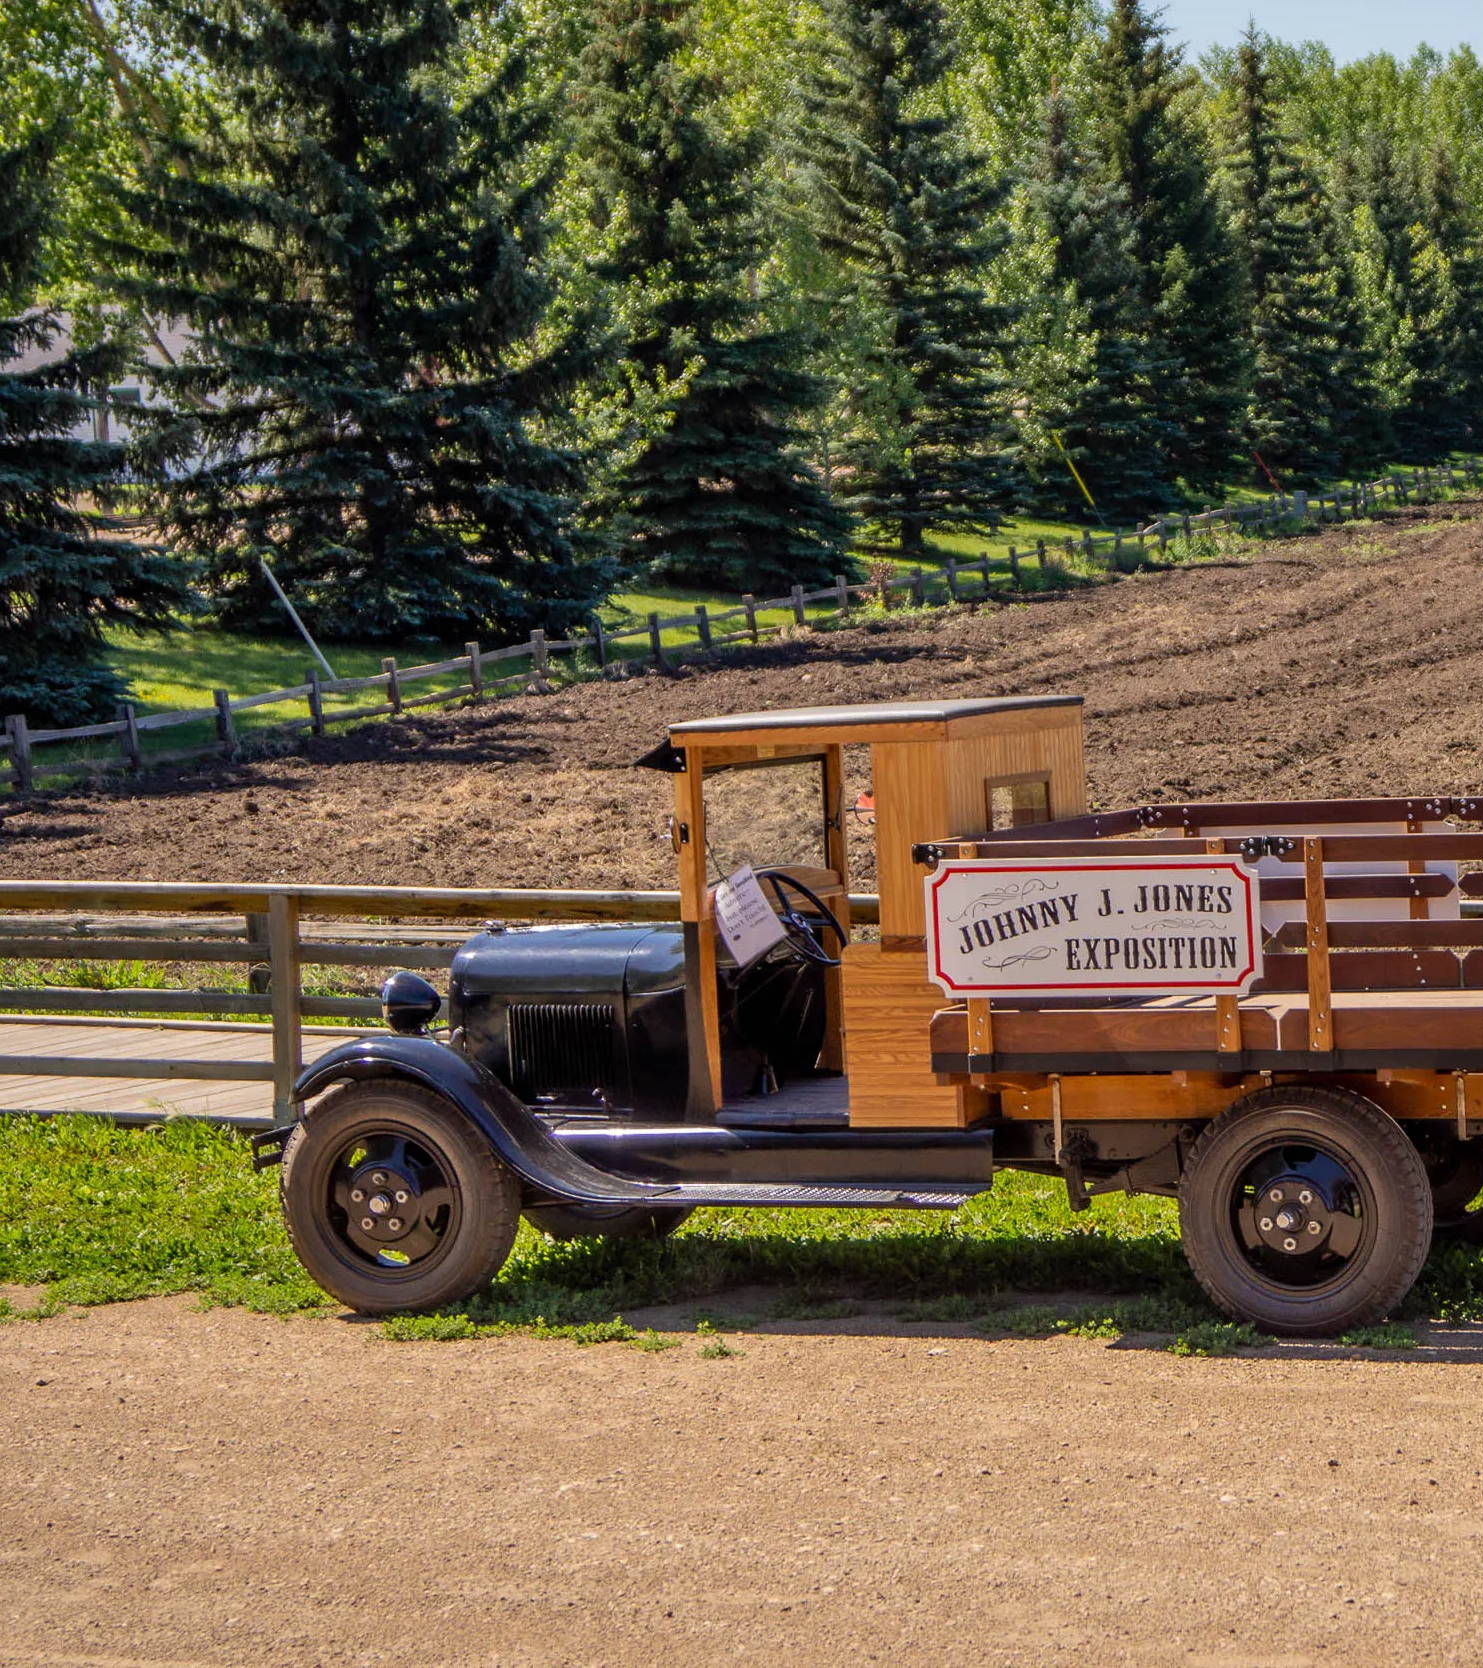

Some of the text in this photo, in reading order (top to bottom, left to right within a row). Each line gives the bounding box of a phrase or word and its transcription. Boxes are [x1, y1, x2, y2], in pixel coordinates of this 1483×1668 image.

[959, 884, 1233, 955] JOHNNY J. JONES
[1065, 936, 1237, 970] EXPOSITION
